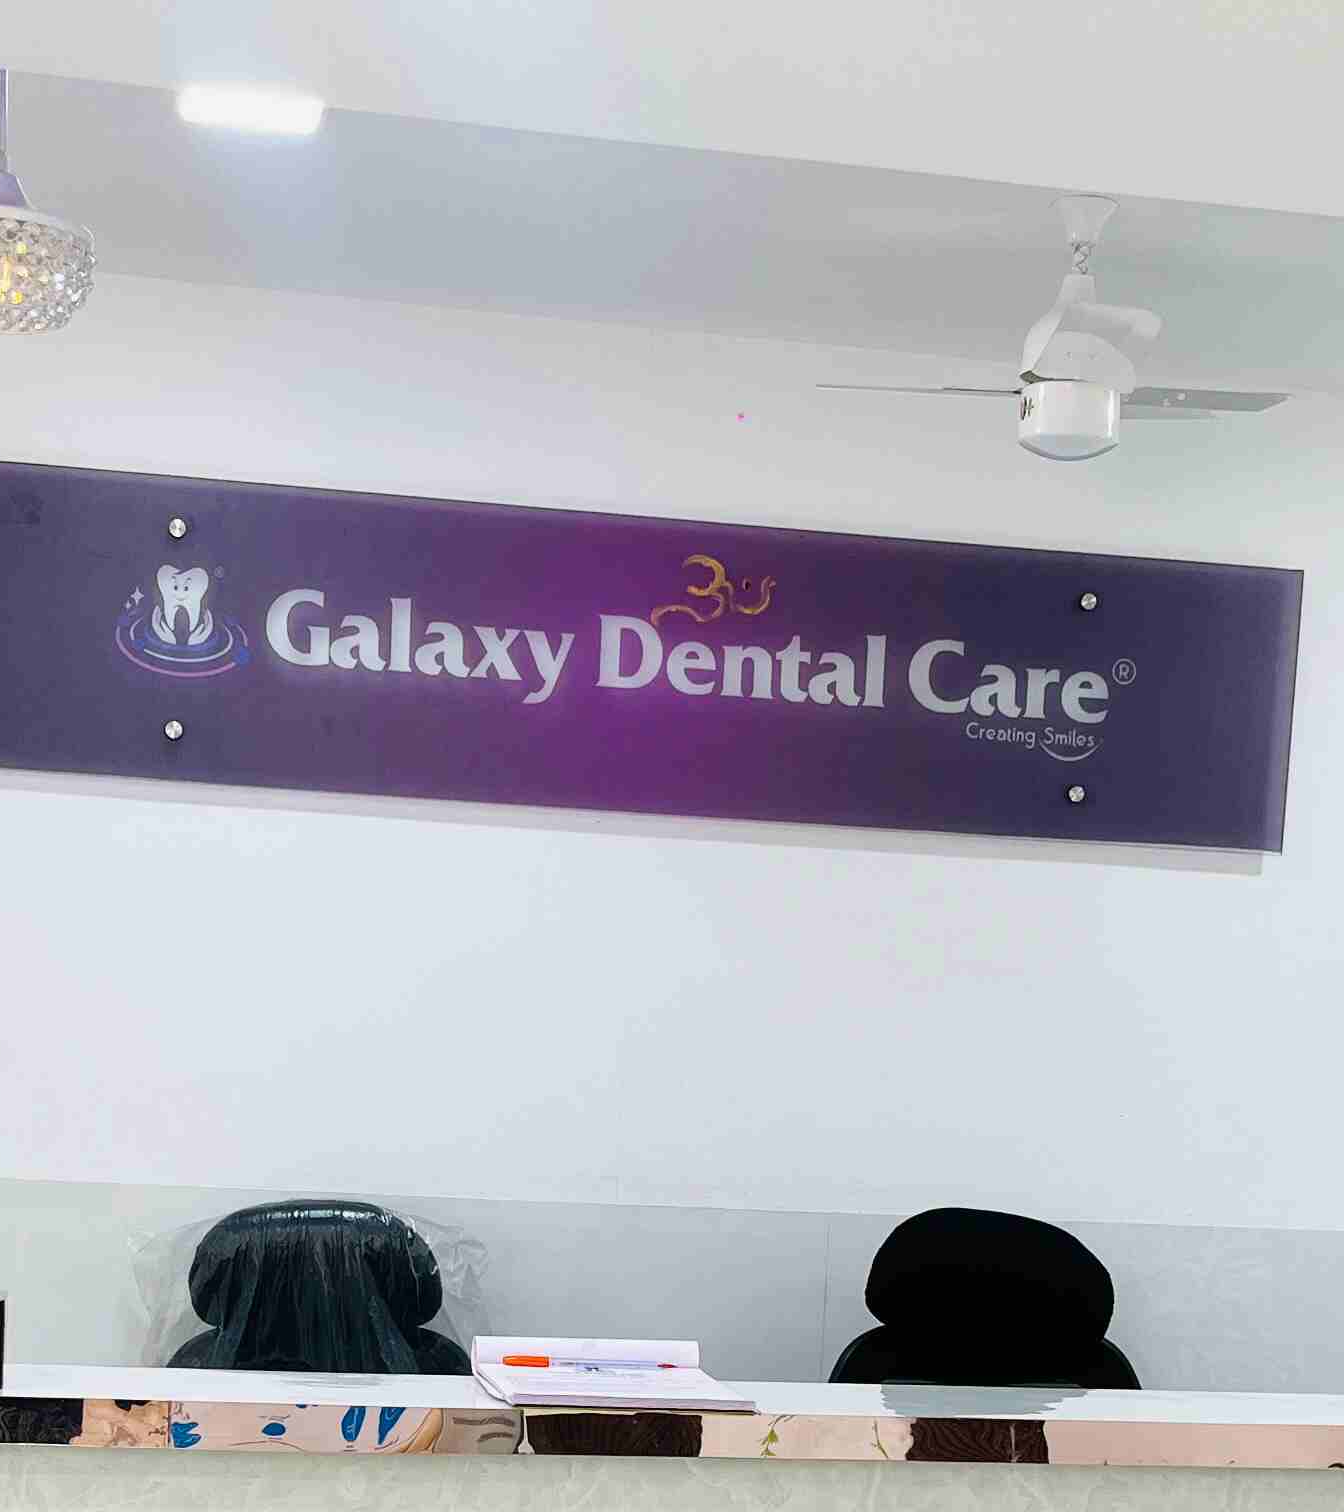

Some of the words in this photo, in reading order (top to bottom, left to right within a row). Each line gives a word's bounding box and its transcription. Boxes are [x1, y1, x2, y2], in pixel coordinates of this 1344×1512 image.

[265, 588, 575, 704] Galaxy
[596, 614, 886, 707] Dental
[966, 722, 1037, 750] Creating
[1043, 727, 1096, 748] Smiles
